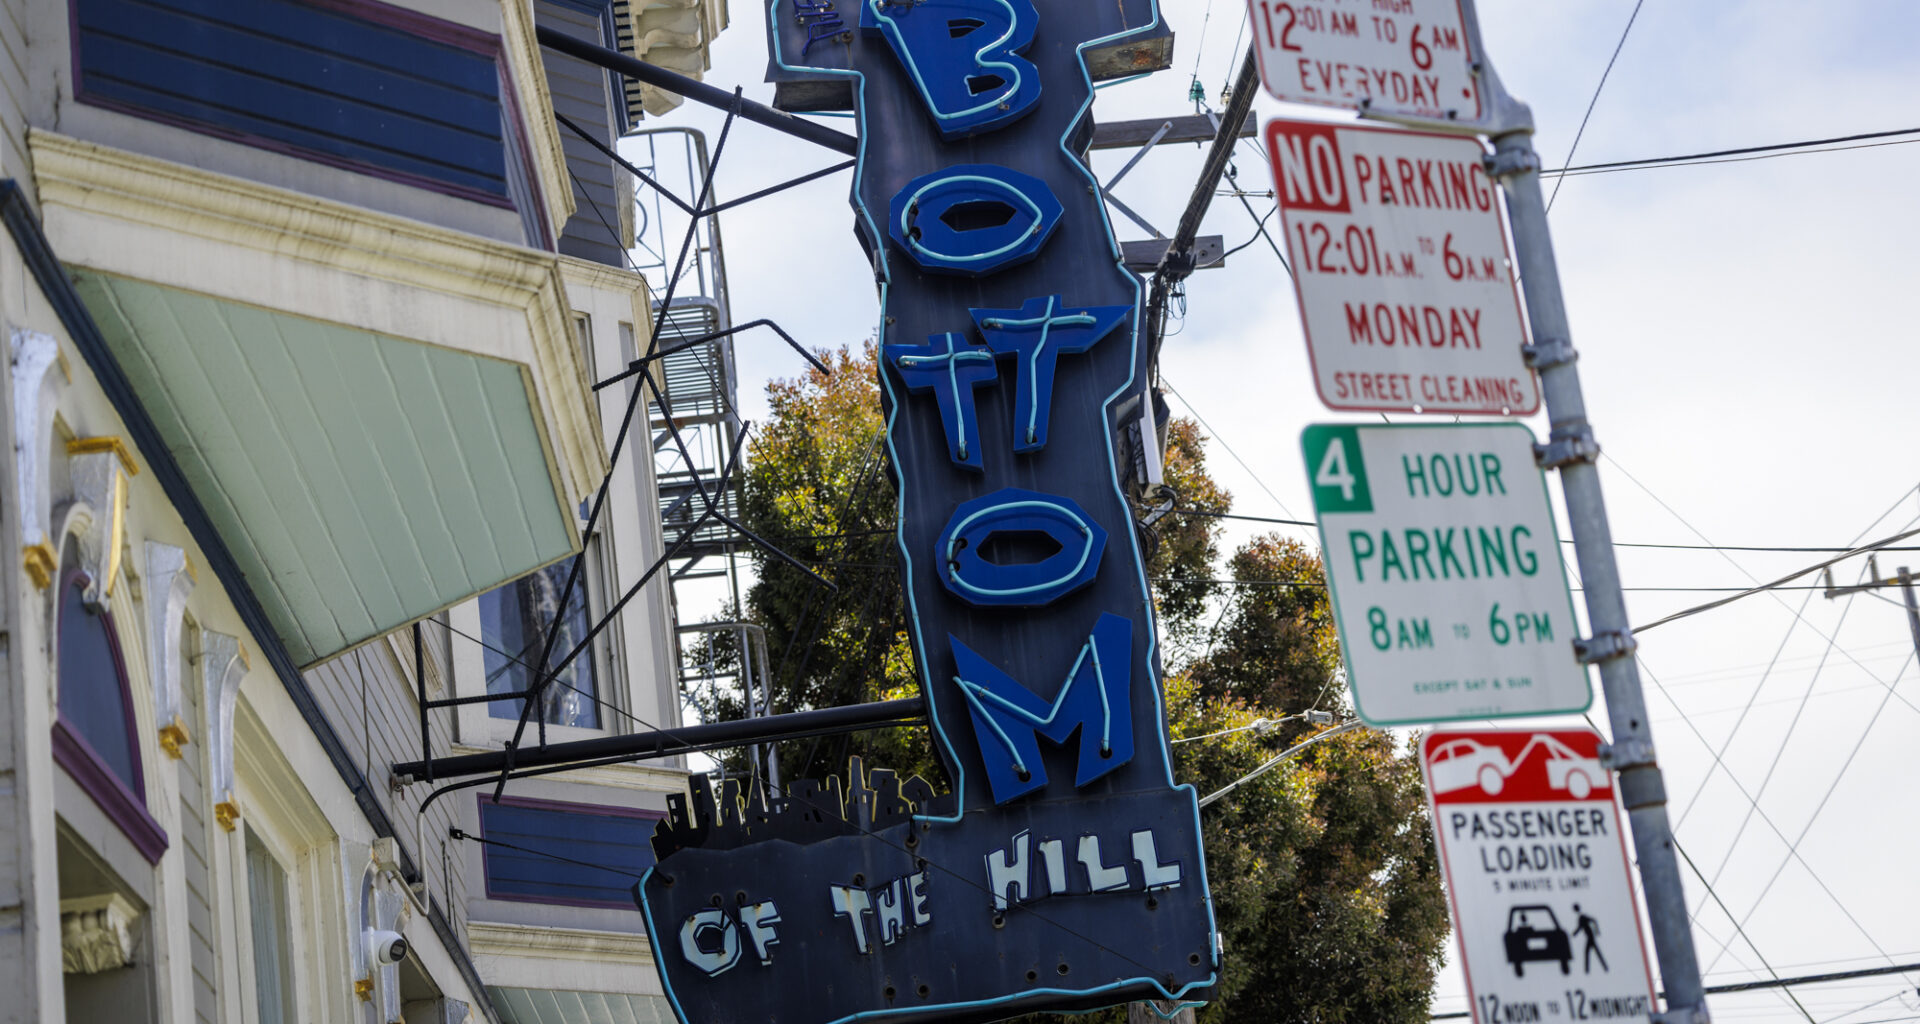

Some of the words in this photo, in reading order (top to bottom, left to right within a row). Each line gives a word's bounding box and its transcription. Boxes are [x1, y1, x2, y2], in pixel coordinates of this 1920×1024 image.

[1371, 16, 1397, 43] TO
[1298, 58, 1440, 108] EVERYDAY
[1274, 133, 1344, 207] NO
[1353, 153, 1492, 213] PARKING
[1417, 236, 1435, 255] TO
[1345, 302, 1482, 350] MONDAY
[862, 0, 1135, 804] BOTTOM
[1334, 370, 1413, 401] STREET
[1420, 374, 1524, 404] CLEANING
[1315, 436, 1356, 501] 4
[1401, 452, 1507, 499] HOUR
[1349, 524, 1539, 583] PARKING
[1452, 623, 1469, 640] TO
[1413, 680, 1459, 695] EXCEPT
[1464, 678, 1487, 692] SAT
[1506, 677, 1533, 690] SUN
[1451, 808, 1609, 840] PASSENGER
[1481, 843, 1592, 874] LOADING
[1508, 878, 1553, 892] MINUTE
[1559, 876, 1590, 890] LIMIT
[680, 897, 782, 977] OF
[830, 871, 931, 955] THE
[984, 828, 1185, 912] HILL
